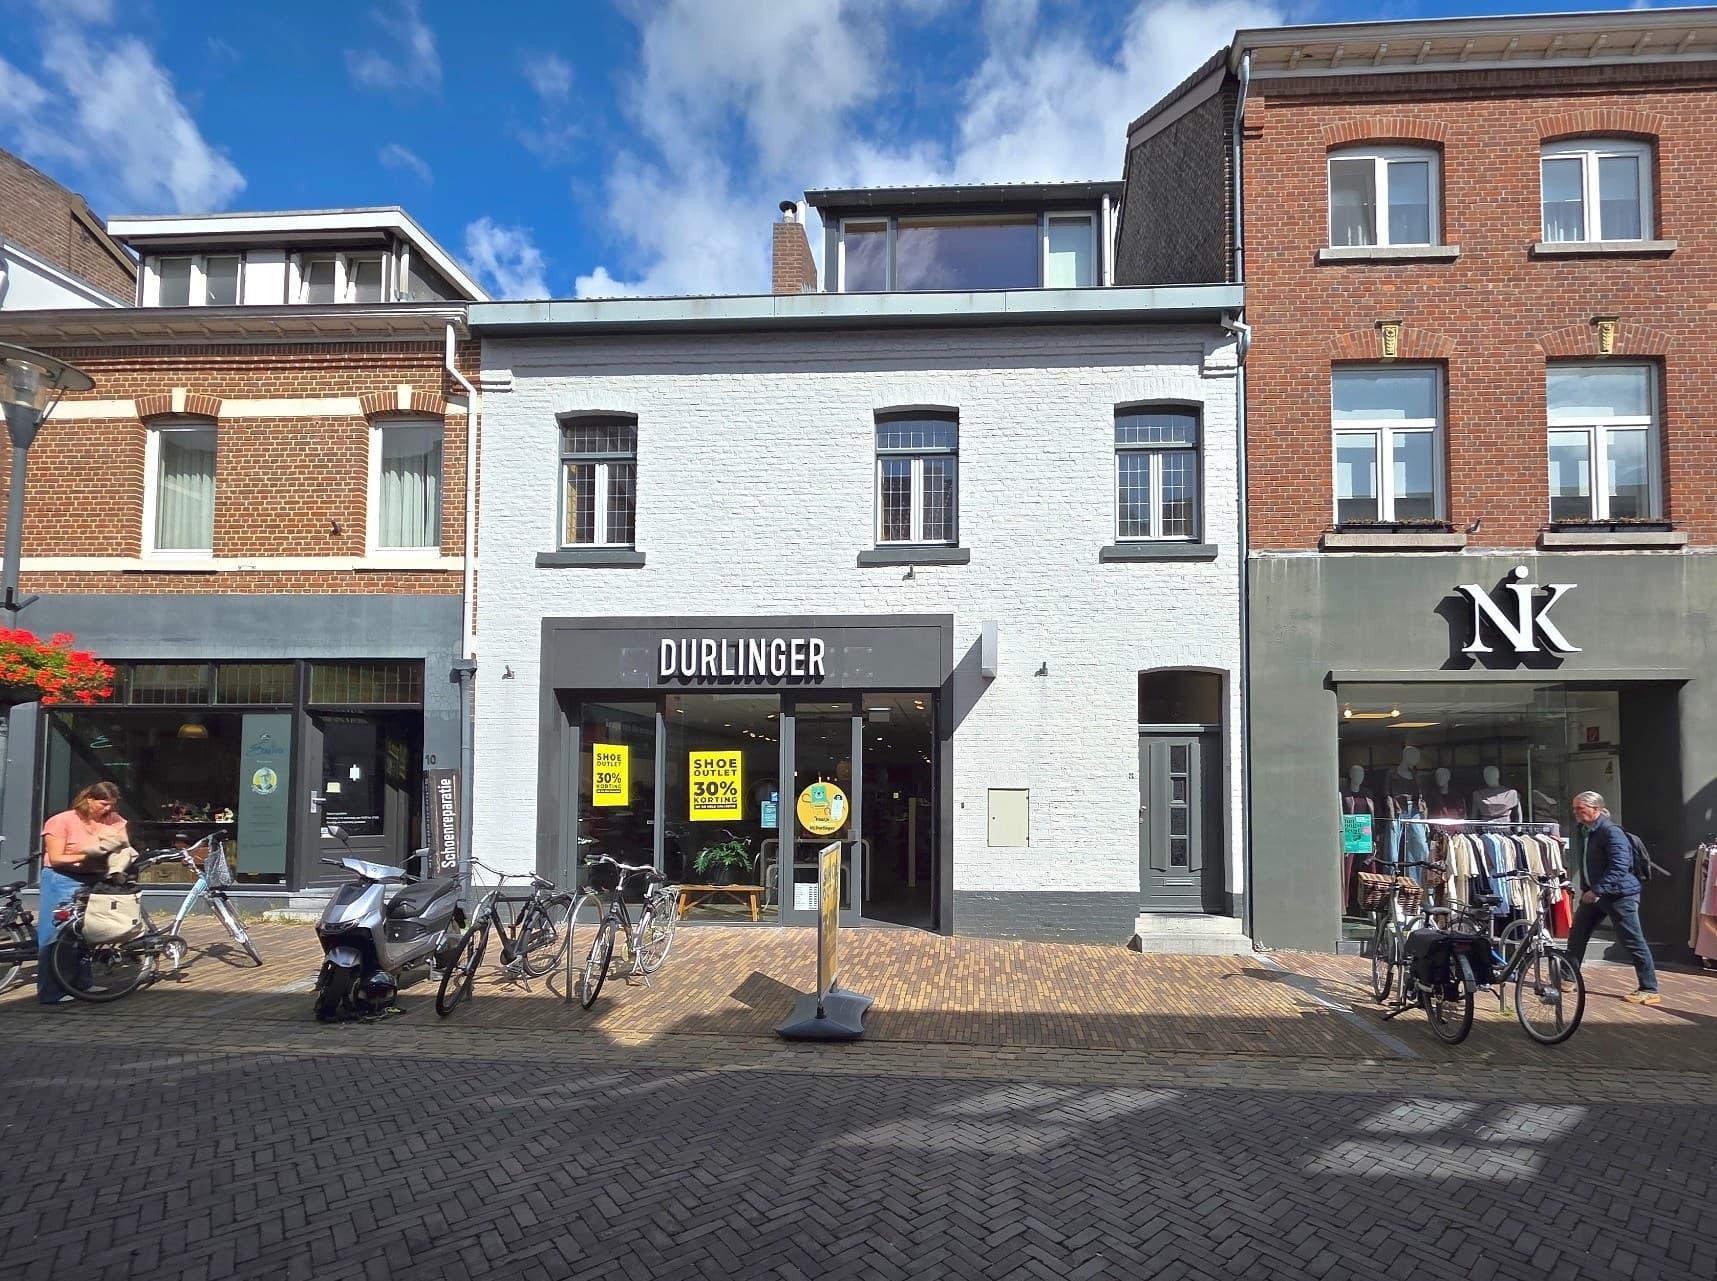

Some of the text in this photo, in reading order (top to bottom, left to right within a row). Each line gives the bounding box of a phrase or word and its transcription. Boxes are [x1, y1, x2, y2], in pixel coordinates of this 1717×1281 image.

[660, 637, 825, 677] DURLINGER
[425, 754, 437, 765] 10
[596, 753, 622, 762] SHOE
[694, 758, 737, 769] SHOE
[596, 772, 622, 784] 30%
[694, 781, 738, 797] 30%
[438, 778, 457, 869] Schoenreparatie
